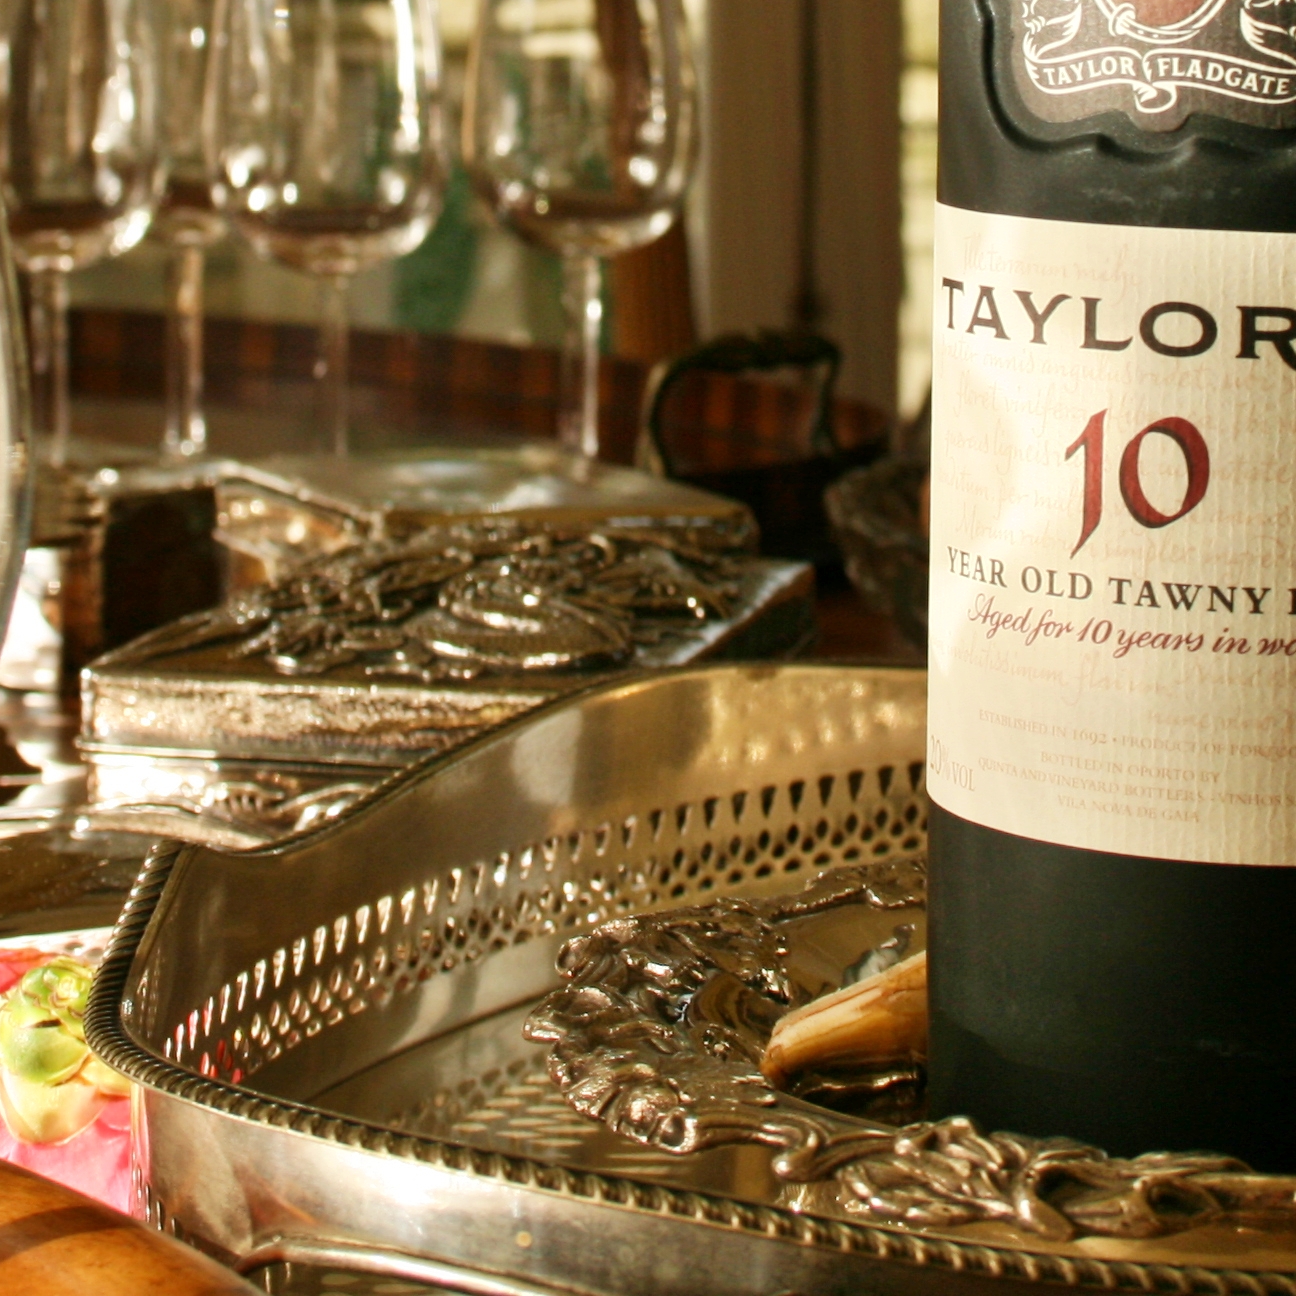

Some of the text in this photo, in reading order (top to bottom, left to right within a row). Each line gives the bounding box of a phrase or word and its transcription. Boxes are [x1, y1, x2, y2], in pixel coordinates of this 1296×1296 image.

[1043, 54, 1291, 97] TAYLOR FLADGATE
[1065, 408, 1211, 559] 10
[947, 546, 1007, 588] YEAR
[1021, 565, 1093, 600] OLD
[1108, 577, 1271, 615] TAWNY
[968, 592, 1032, 639] Aged
[1025, 609, 1074, 646] for
[1076, 616, 1113, 644] 10
[1113, 628, 1204, 658] years
[1212, 628, 1251, 654] in
[979, 708, 1047, 734] ESTABLISHED
[1052, 725, 1066, 738] IN
[1073, 729, 1107, 745] 1692
[1121, 735, 1198, 753] PRODUCT
[951, 761, 976, 792] VOL
[979, 756, 1018, 777] QUINTA
[1020, 767, 1047, 782] AND
[1047, 772, 1119, 794] VINEYARD
[1124, 784, 1204, 802] BOTTLERS
[1041, 751, 1219, 783] BOTTLED IN OPORTO BY
[1058, 795, 1200, 823] VILA NOVA DE GAIA
